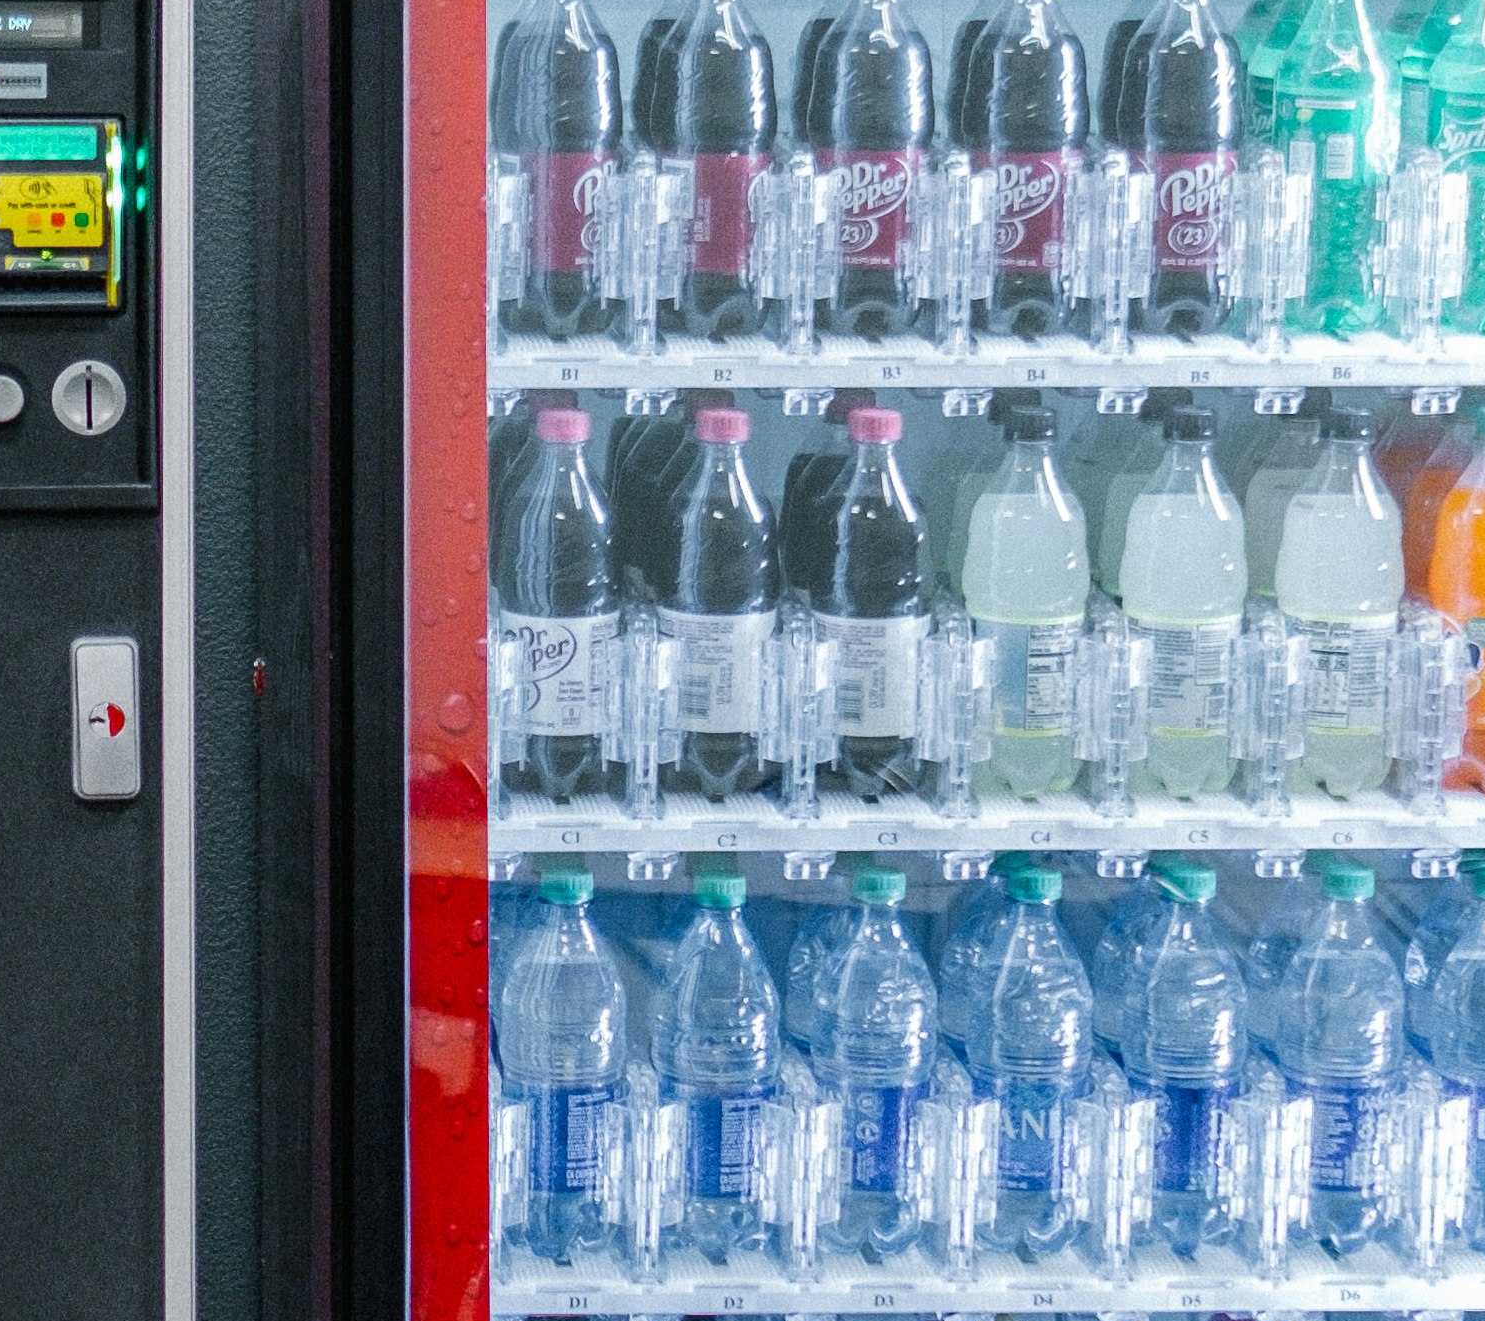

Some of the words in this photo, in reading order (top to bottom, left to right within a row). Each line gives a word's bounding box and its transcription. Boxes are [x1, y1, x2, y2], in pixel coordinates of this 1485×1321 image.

[8, 15, 32, 32] DAY
[853, 162, 886, 187] Dr
[561, 368, 580, 381] B1
[713, 368, 733, 381] B2
[882, 367, 902, 380] B3
[1027, 369, 1047, 382] B4
[1190, 370, 1211, 384] B5
[1331, 367, 1352, 380] B6
[561, 831, 582, 845] C1
[717, 834, 738, 848] C2
[877, 831, 898, 845] C3
[1030, 831, 1051, 845] C4
[1188, 830, 1209, 844] C5
[1332, 831, 1353, 846] C6
[874, 1293, 895, 1308] D3
[1032, 1292, 1053, 1307] D4
[1182, 1294, 1202, 1307] D5
[1339, 1288, 1361, 1302] D6
[569, 1295, 589, 1310] D1
[723, 1295, 745, 1310] D2
